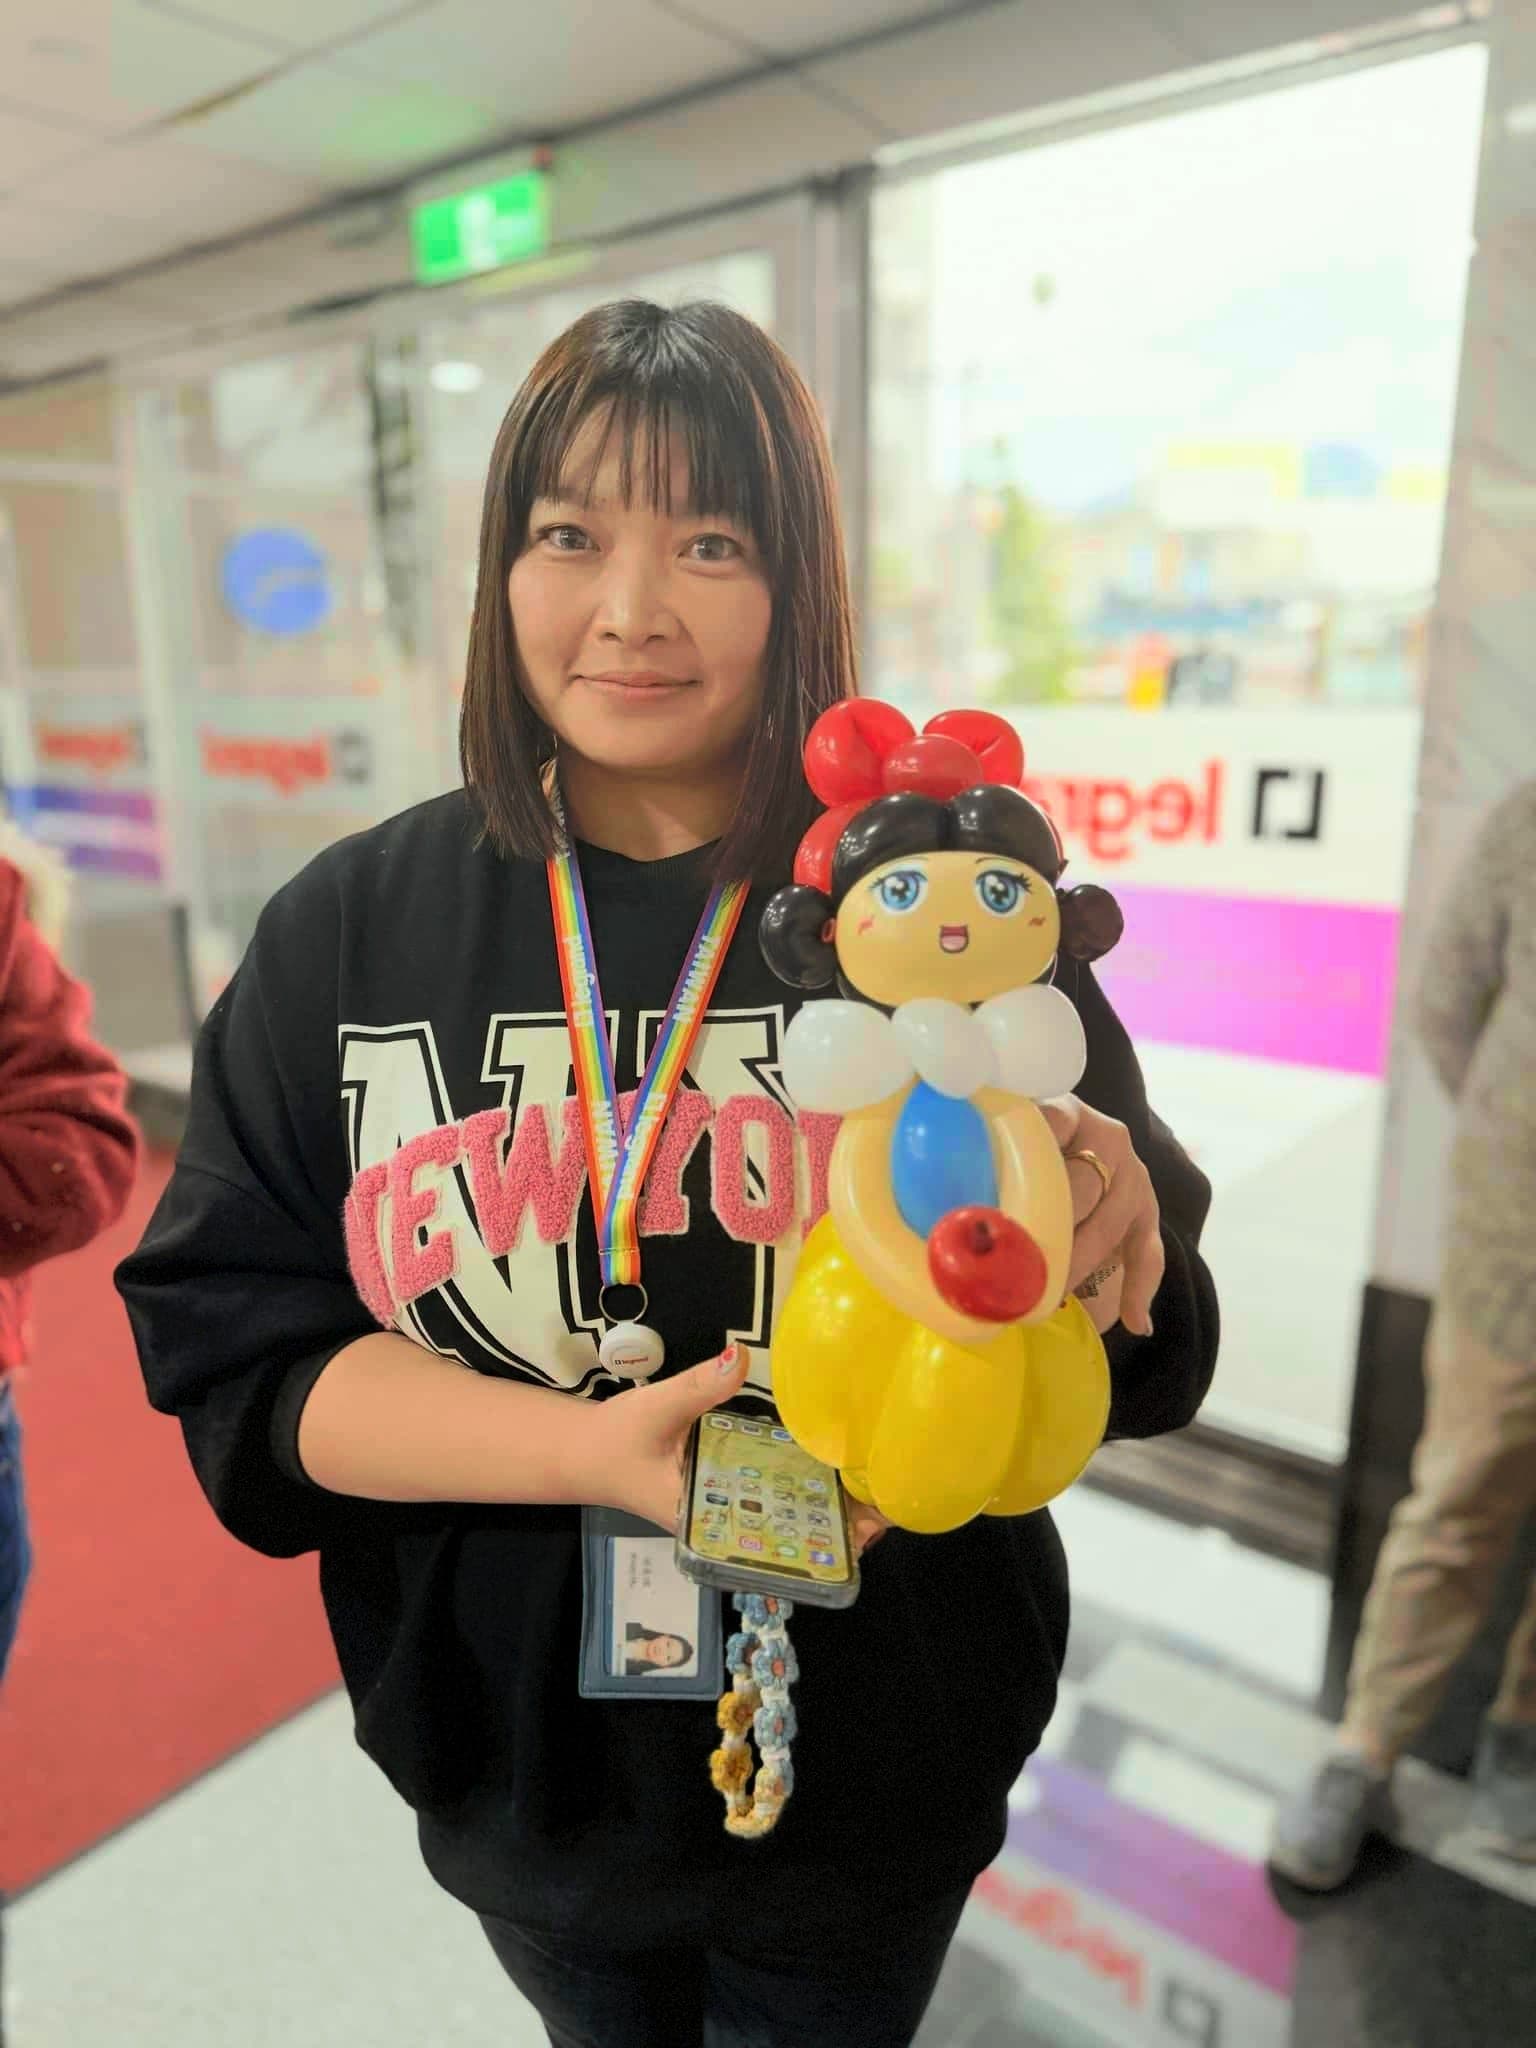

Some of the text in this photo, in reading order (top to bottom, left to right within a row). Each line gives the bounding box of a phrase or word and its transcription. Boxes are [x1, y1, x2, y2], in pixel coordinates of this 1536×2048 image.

[563, 934, 596, 1009] legrand
[672, 934, 722, 1024] TAIWAN
[592, 1100, 619, 1186] IWAN
